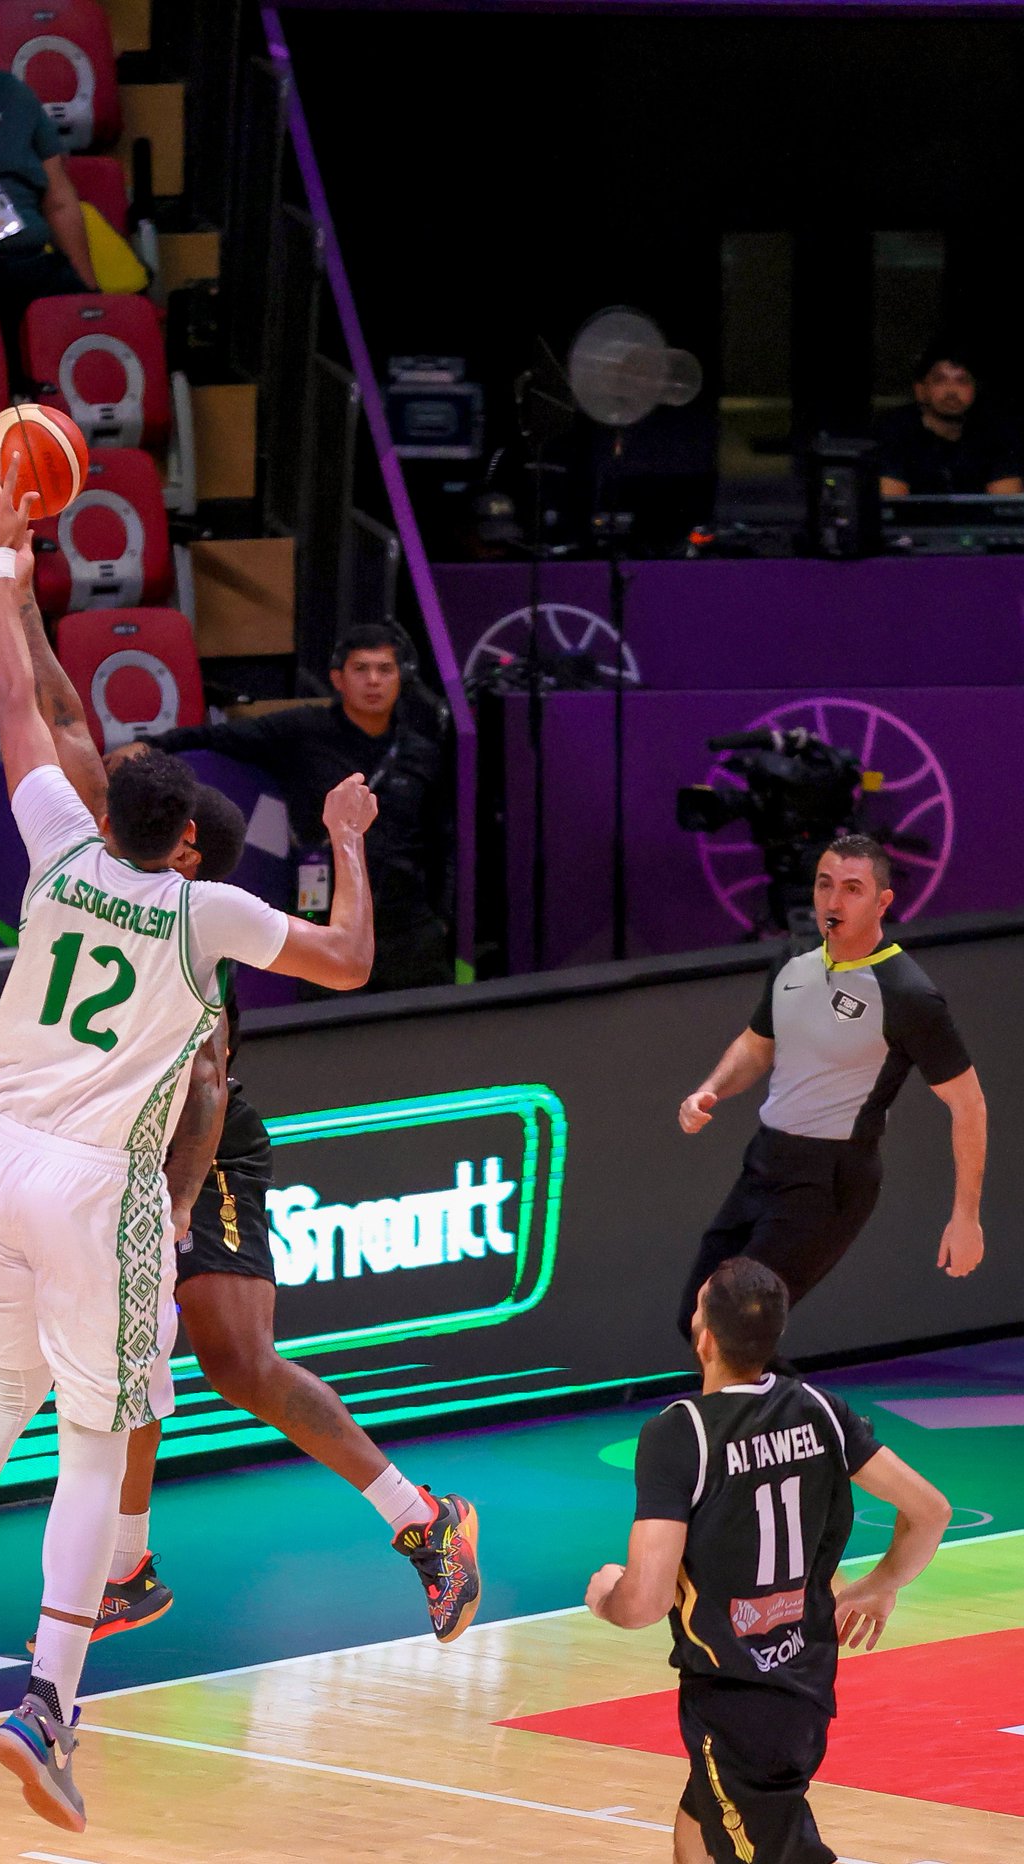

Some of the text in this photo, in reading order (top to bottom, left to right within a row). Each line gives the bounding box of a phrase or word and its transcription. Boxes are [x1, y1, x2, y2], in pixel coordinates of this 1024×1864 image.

[38, 931, 137, 1053] 12
[839, 995, 858, 1011] FIBA
[726, 1422, 826, 1476] AL TAWEEL
[755, 1475, 805, 1587] 11
